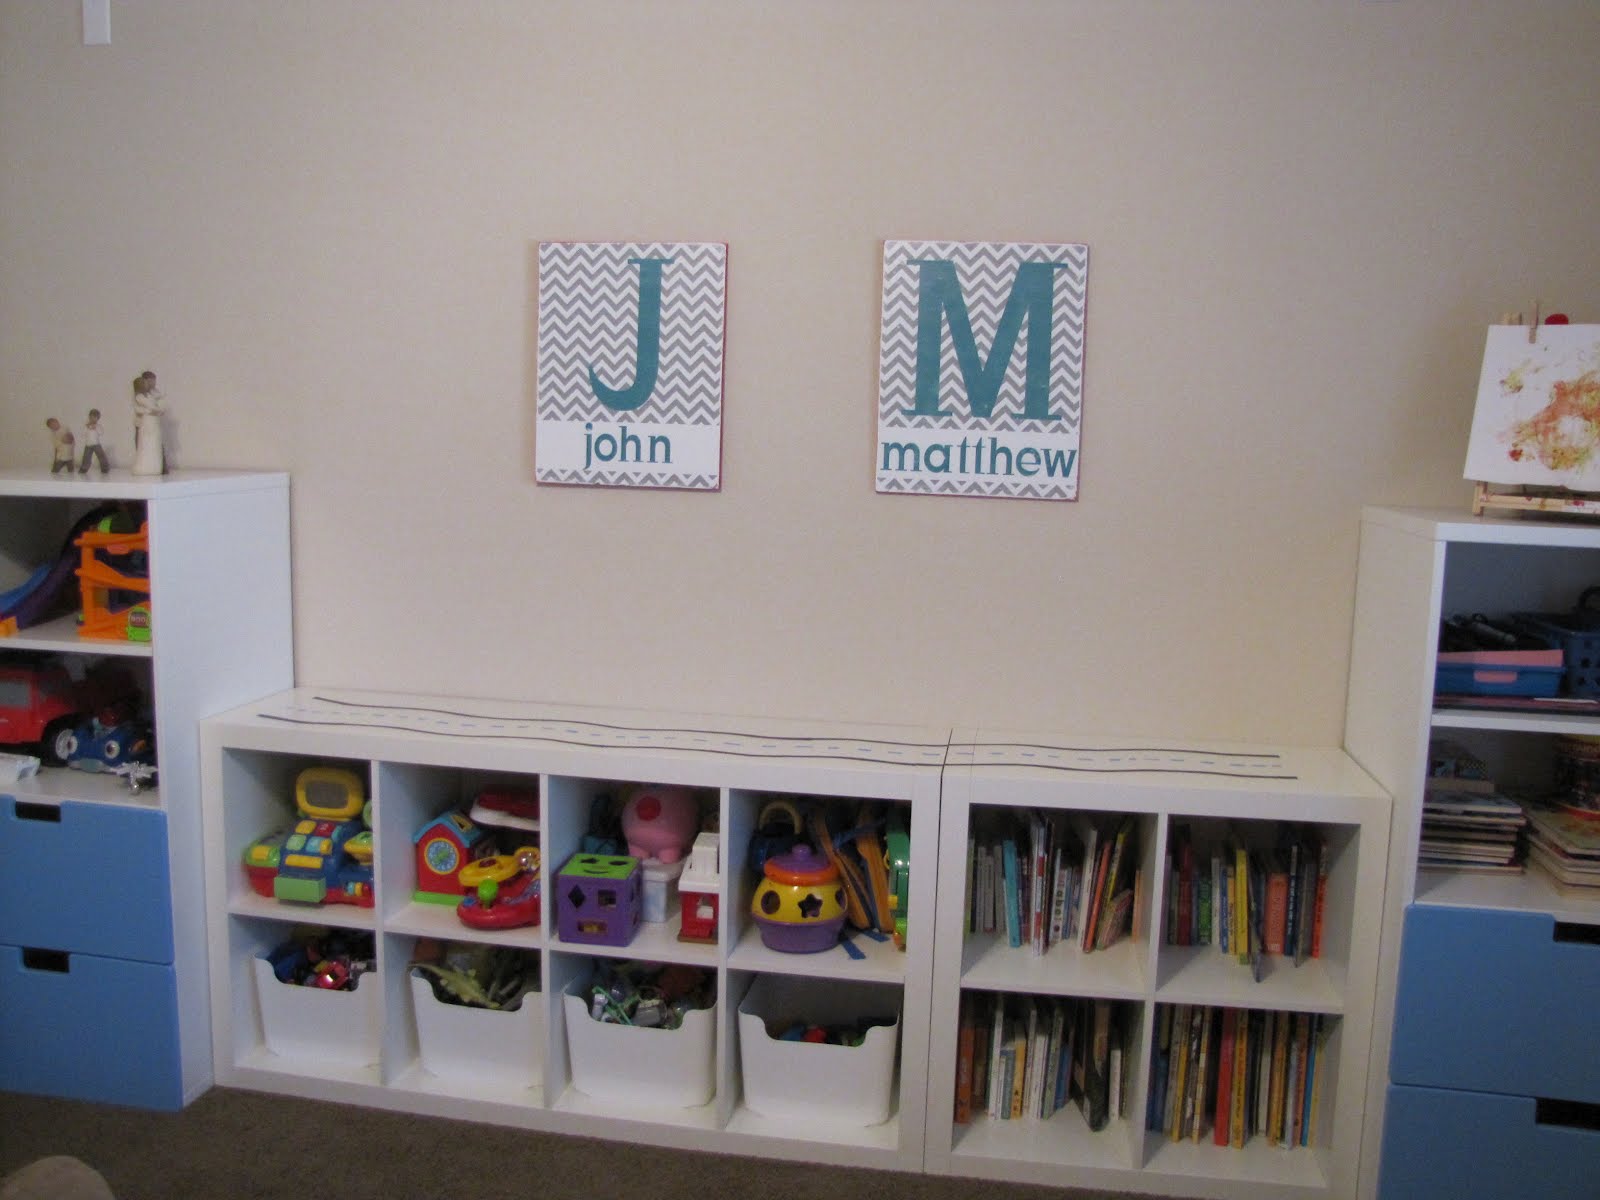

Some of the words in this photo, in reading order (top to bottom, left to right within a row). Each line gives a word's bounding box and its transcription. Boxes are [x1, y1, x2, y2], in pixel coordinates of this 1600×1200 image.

[588, 258, 675, 412] J
[900, 258, 1069, 421] M
[583, 422, 673, 470] john
[881, 436, 1077, 479] matthew
